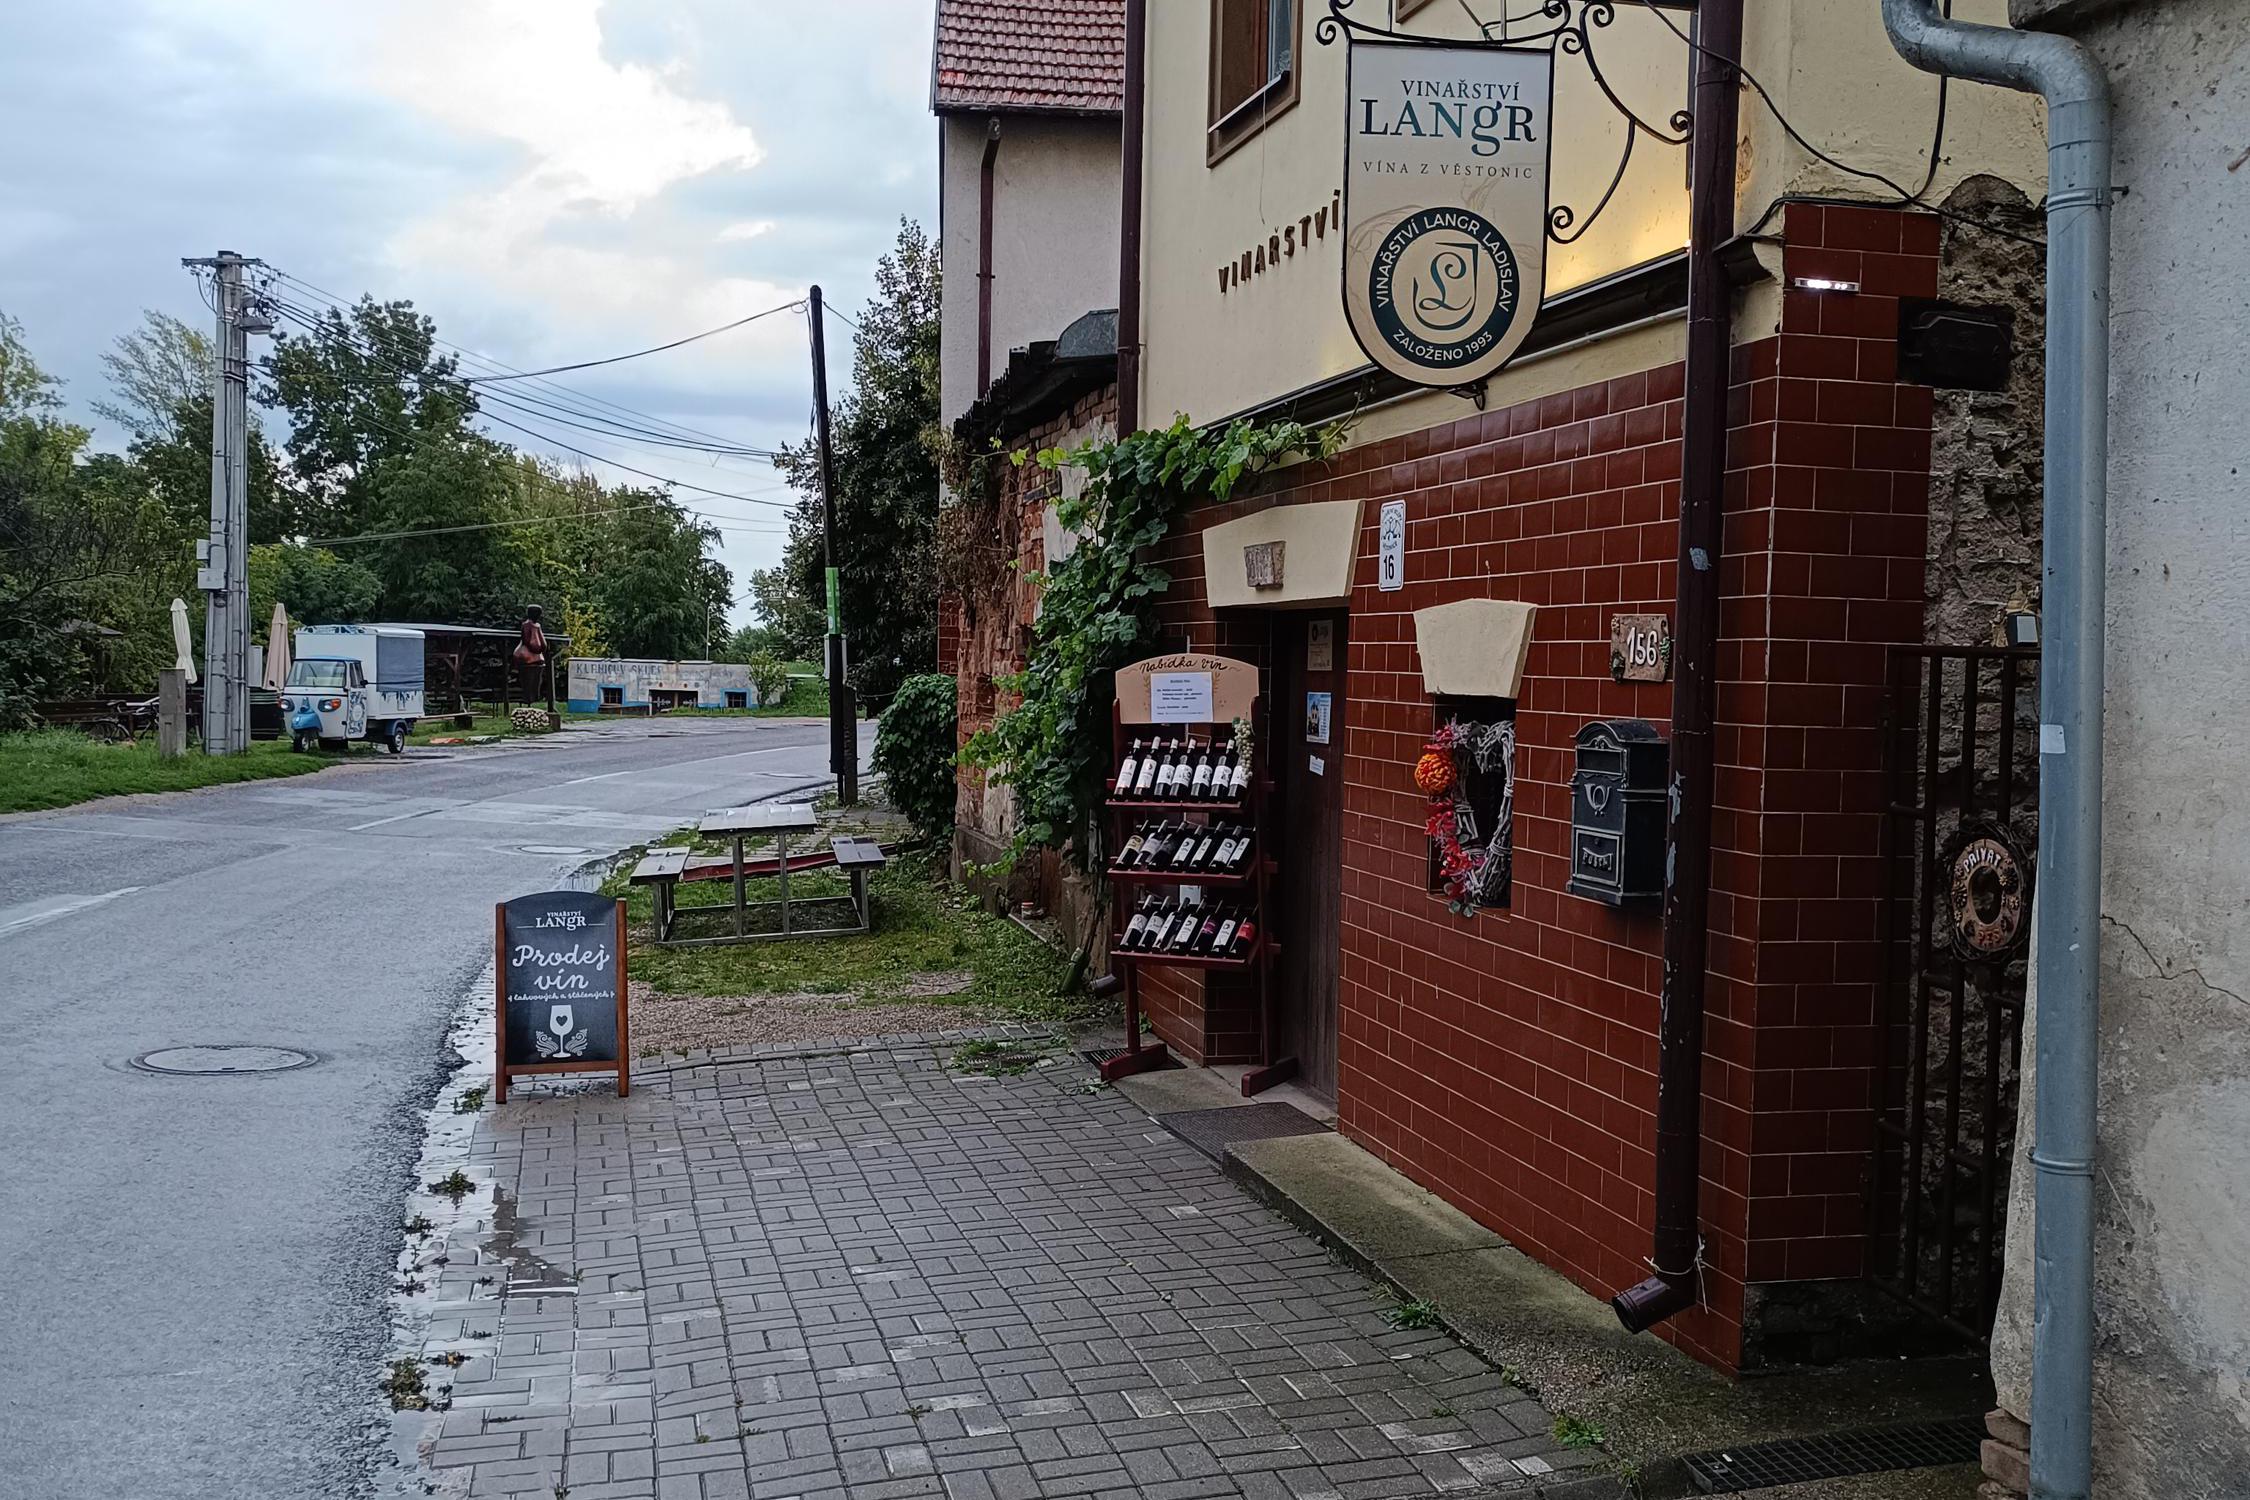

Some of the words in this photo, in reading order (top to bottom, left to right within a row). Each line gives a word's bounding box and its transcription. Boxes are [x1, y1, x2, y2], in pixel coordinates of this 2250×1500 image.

[1401, 79, 1520, 101] VINAŘSTVÍ
[1363, 160, 1409, 174] VÍNA
[1420, 163, 1429, 175] Z
[1440, 163, 1533, 179] VĚSTONIC
[1219, 189, 1341, 294] VINAŘSTVÍ
[1376, 221, 1420, 309] VINAŘSTVÍ
[1424, 212, 1481, 235] LANGR
[1481, 231, 1513, 313] LADISLAV
[1392, 328, 1464, 361] ZALOŽENO
[1465, 330, 1494, 356] 1993
[1383, 554, 1395, 580] 16
[1626, 626, 1658, 667] 156
[1963, 847, 2001, 873] PRIVAT
[512, 943, 610, 971] Prodej
[534, 968, 590, 990] vín
